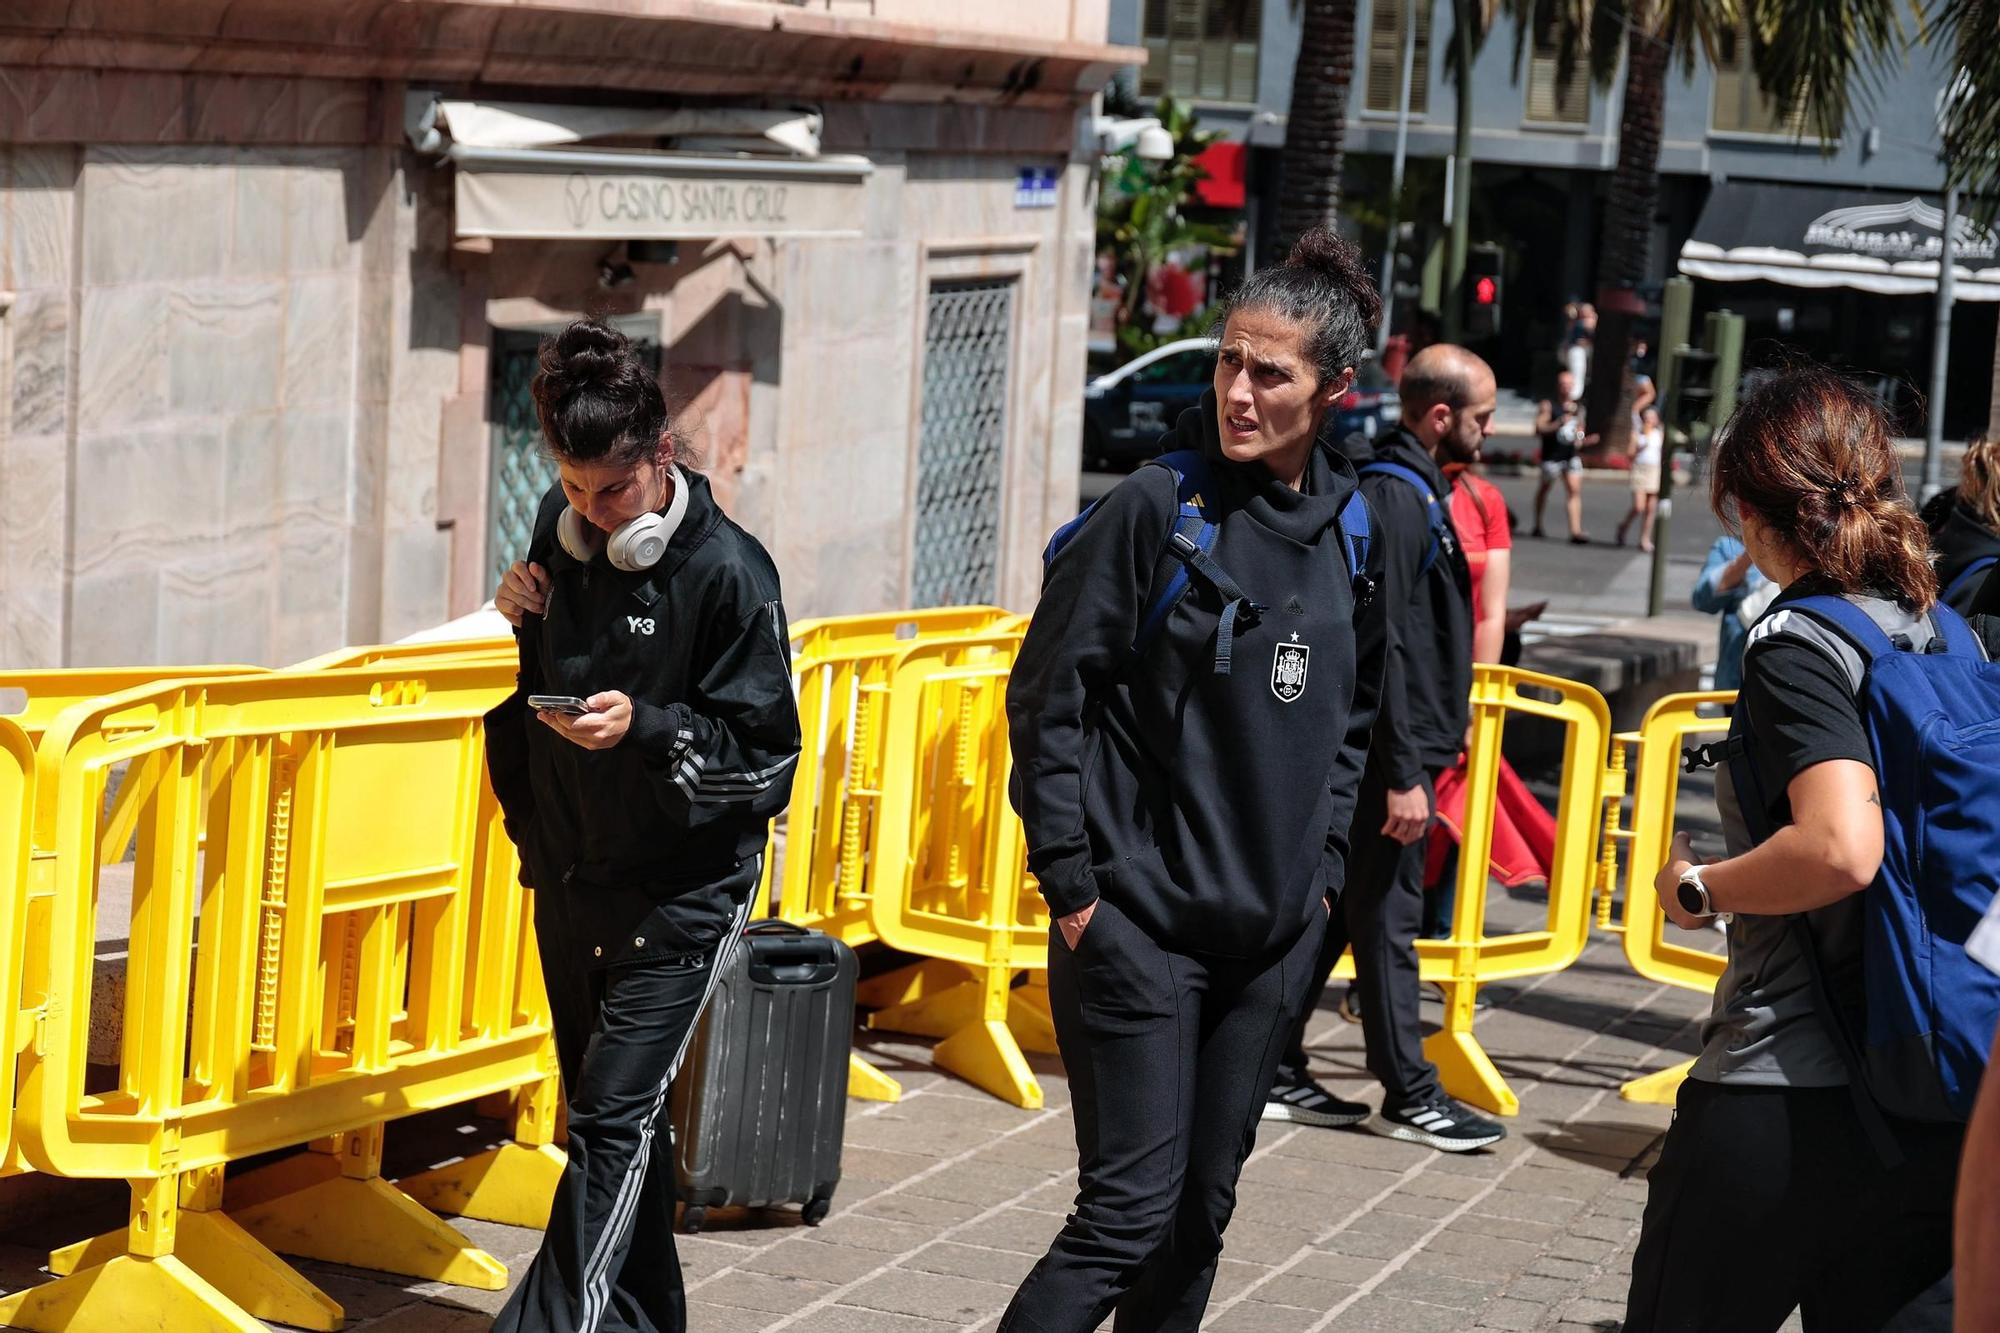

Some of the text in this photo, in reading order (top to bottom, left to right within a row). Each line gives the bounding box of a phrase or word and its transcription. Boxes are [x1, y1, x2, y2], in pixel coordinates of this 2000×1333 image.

[600, 183, 786, 222] CASINO SANTA CRUZ
[627, 616, 656, 636] Y-3
